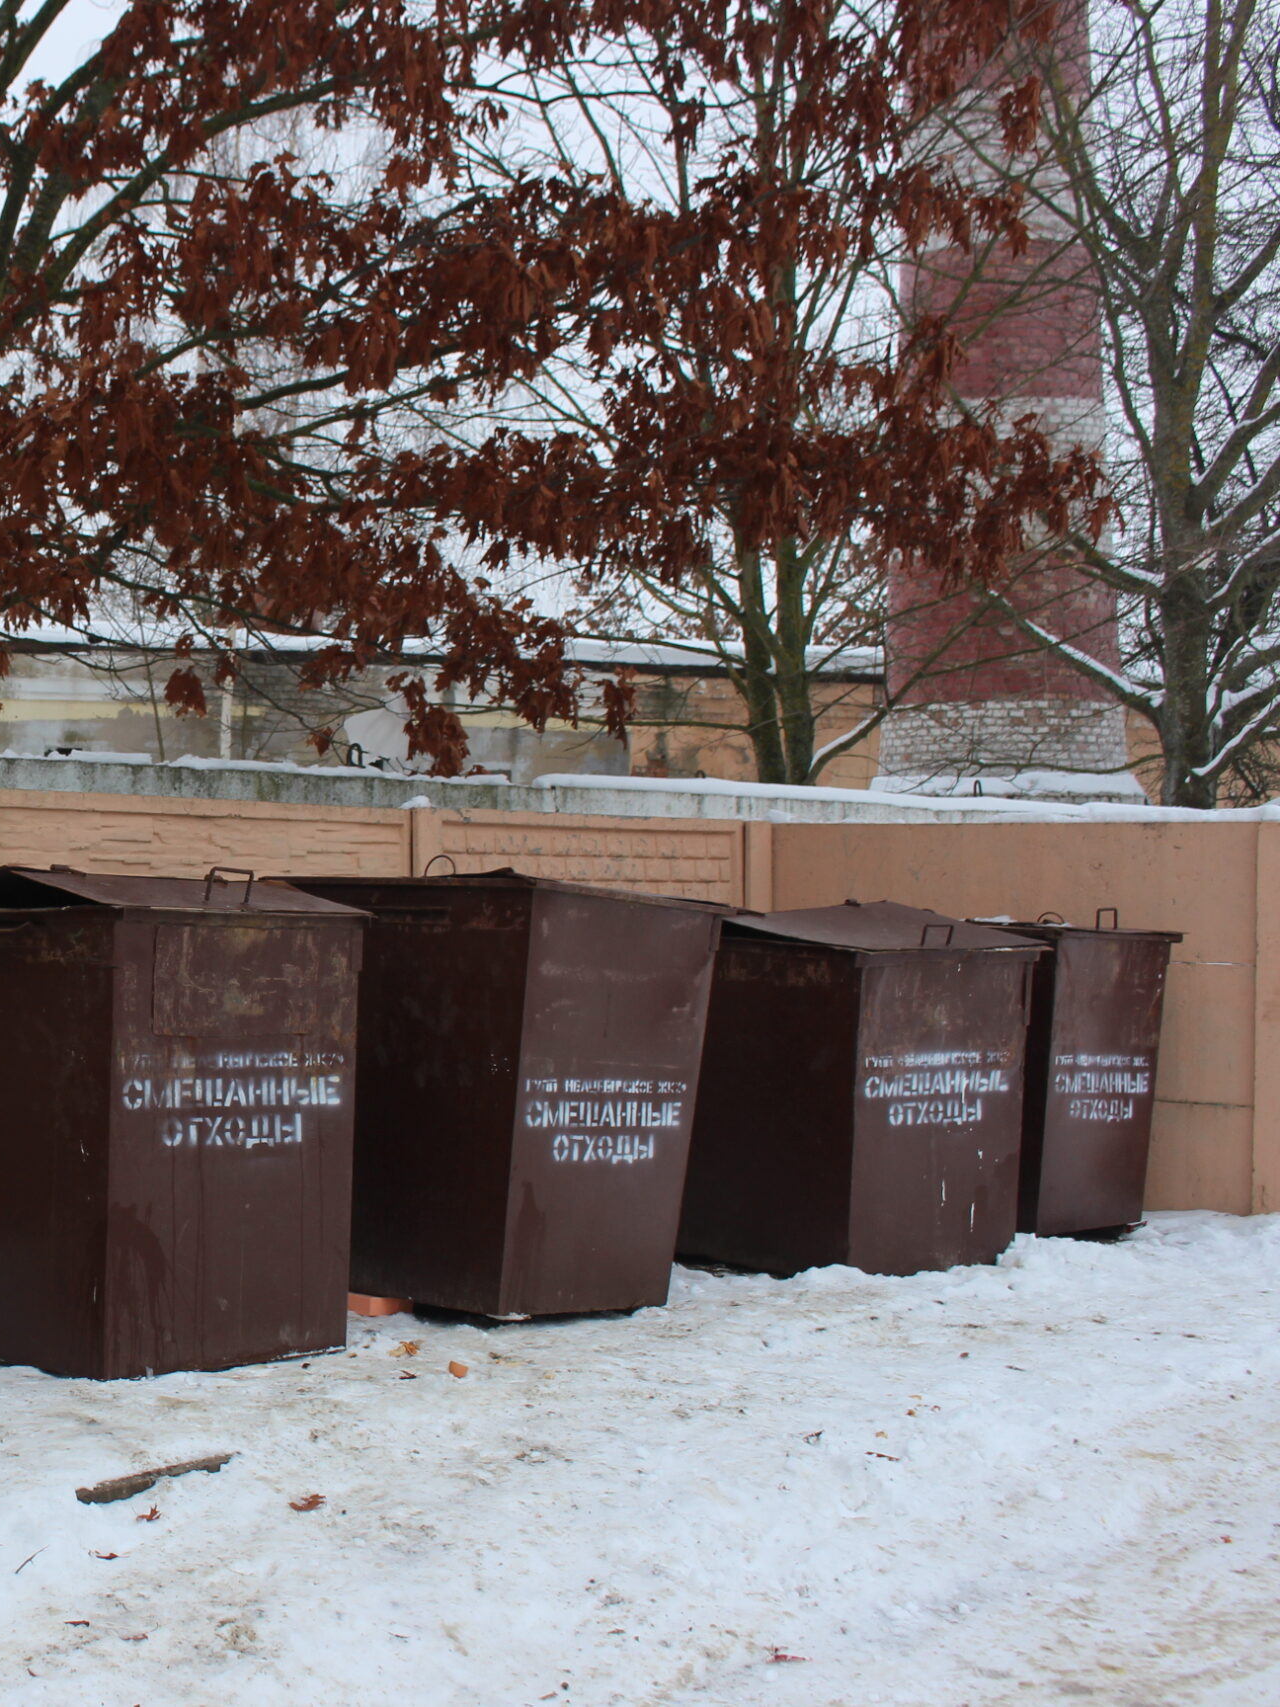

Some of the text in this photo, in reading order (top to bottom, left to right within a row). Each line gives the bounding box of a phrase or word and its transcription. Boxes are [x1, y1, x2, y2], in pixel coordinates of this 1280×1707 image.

[122, 1075, 341, 1110] СМЕШАННЫЕ
[1055, 1072, 1150, 1094] СМЕШАННЫЕ
[525, 1101, 682, 1128] СМЕШАННЫЕ
[888, 1099, 982, 1126] ОТХОДЫ
[1070, 1099, 1133, 1123] ОТХОДЫ
[162, 1112, 303, 1150] ОТХОДЫ
[553, 1134, 655, 1164] ОТХОДЫ
